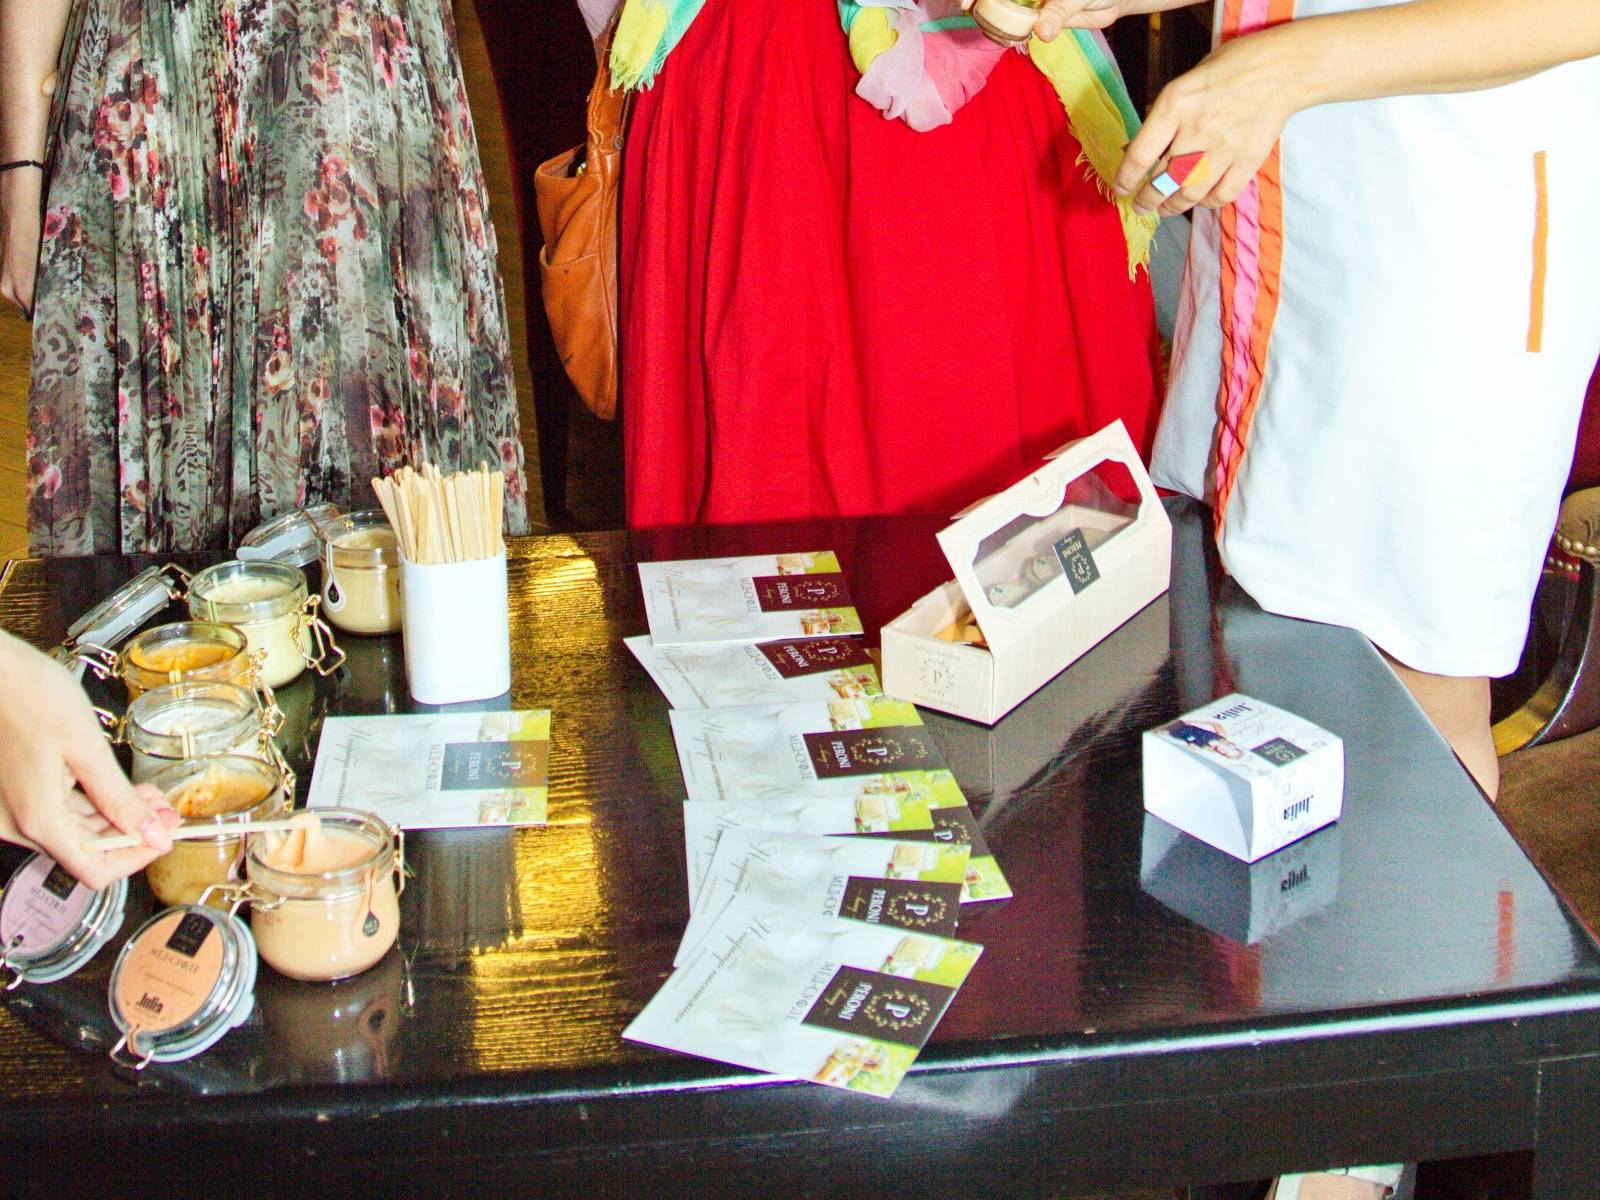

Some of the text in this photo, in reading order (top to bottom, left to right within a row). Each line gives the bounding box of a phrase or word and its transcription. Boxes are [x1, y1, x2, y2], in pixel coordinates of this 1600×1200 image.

[777, 582, 792, 604] PERONI
[807, 587, 826, 596] P
[784, 645, 810, 668] PERONI
[818, 646, 838, 655] P
[1212, 702, 1253, 721] Julia
[831, 740, 852, 769] PERONI
[866, 746, 888, 756] P
[468, 752, 481, 780] PERONI
[501, 761, 521, 770] P
[1283, 794, 1315, 821] Julia
[867, 888, 887, 924] PERONI
[905, 903, 929, 916] P
[135, 992, 164, 1015] Julia
[838, 981, 873, 1020] PERONI
[885, 1001, 911, 1019] P
